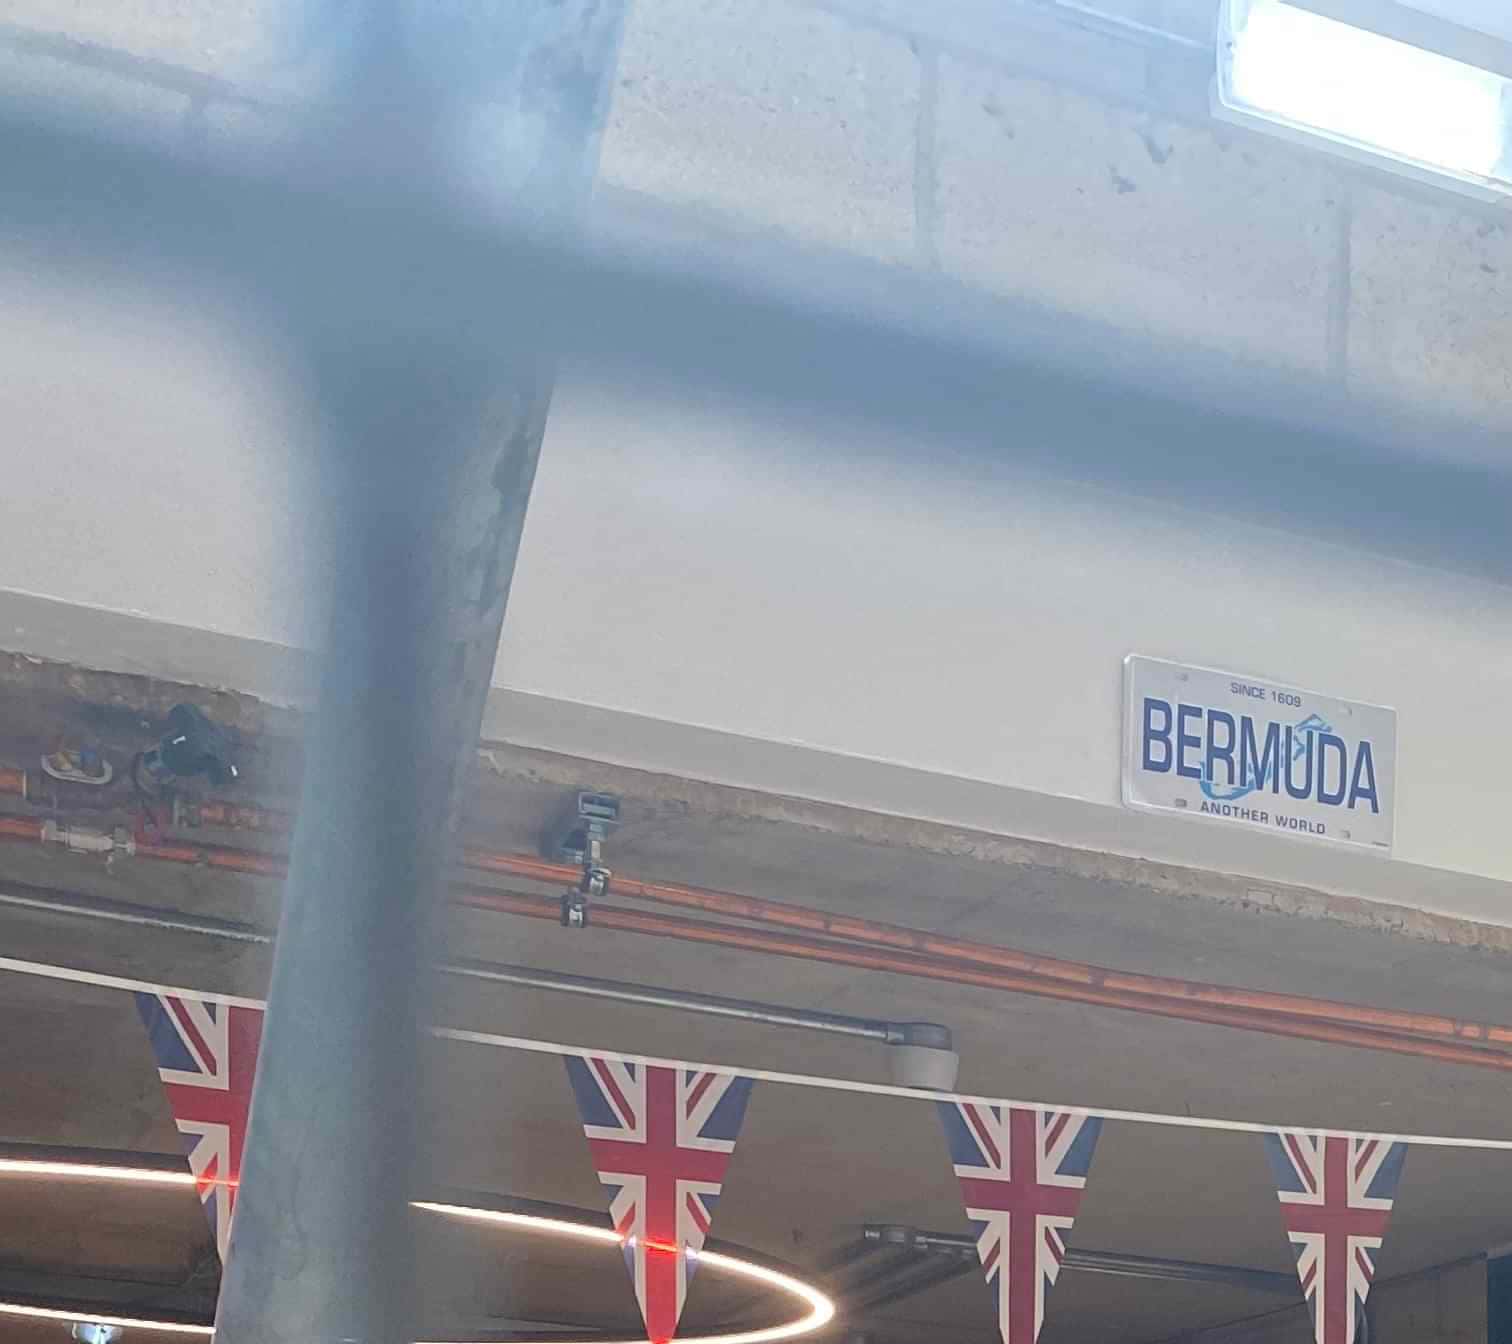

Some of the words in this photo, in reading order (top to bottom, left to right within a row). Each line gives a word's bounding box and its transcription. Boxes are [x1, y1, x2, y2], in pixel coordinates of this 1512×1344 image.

[1230, 682, 1266, 700] SINCE
[1271, 691, 1302, 707] 1609
[1142, 697, 1379, 813] BERMUDA
[1200, 800, 1269, 825] ANOTHER
[1274, 814, 1326, 835] WORLD
